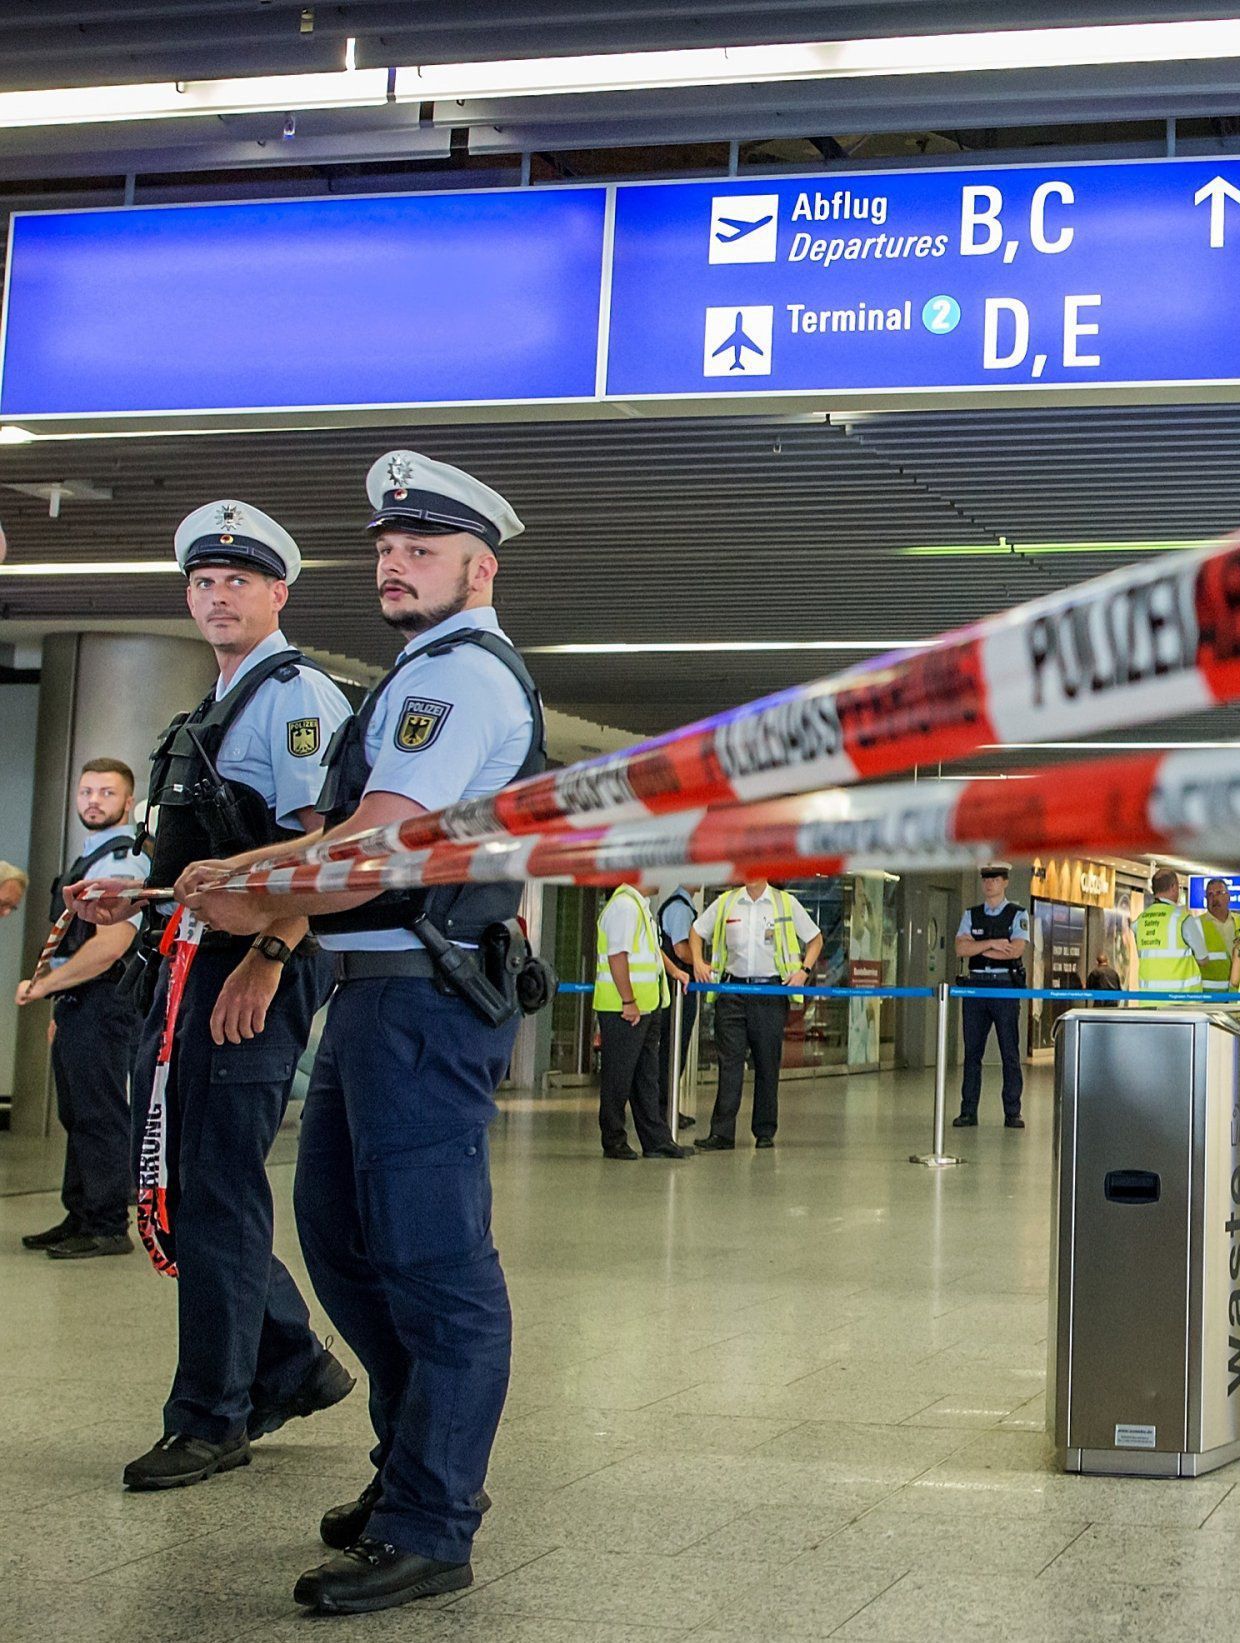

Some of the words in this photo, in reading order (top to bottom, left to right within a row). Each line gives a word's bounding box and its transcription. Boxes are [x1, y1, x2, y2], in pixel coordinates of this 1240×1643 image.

[791, 191, 888, 225] Abflug
[959, 180, 1075, 264] B,C
[788, 232, 948, 267] Departures
[787, 300, 911, 334] Terminal
[983, 294, 1102, 378] D,E
[290, 717, 317, 730] POLIZEI
[407, 701, 444, 715] POLIZEI
